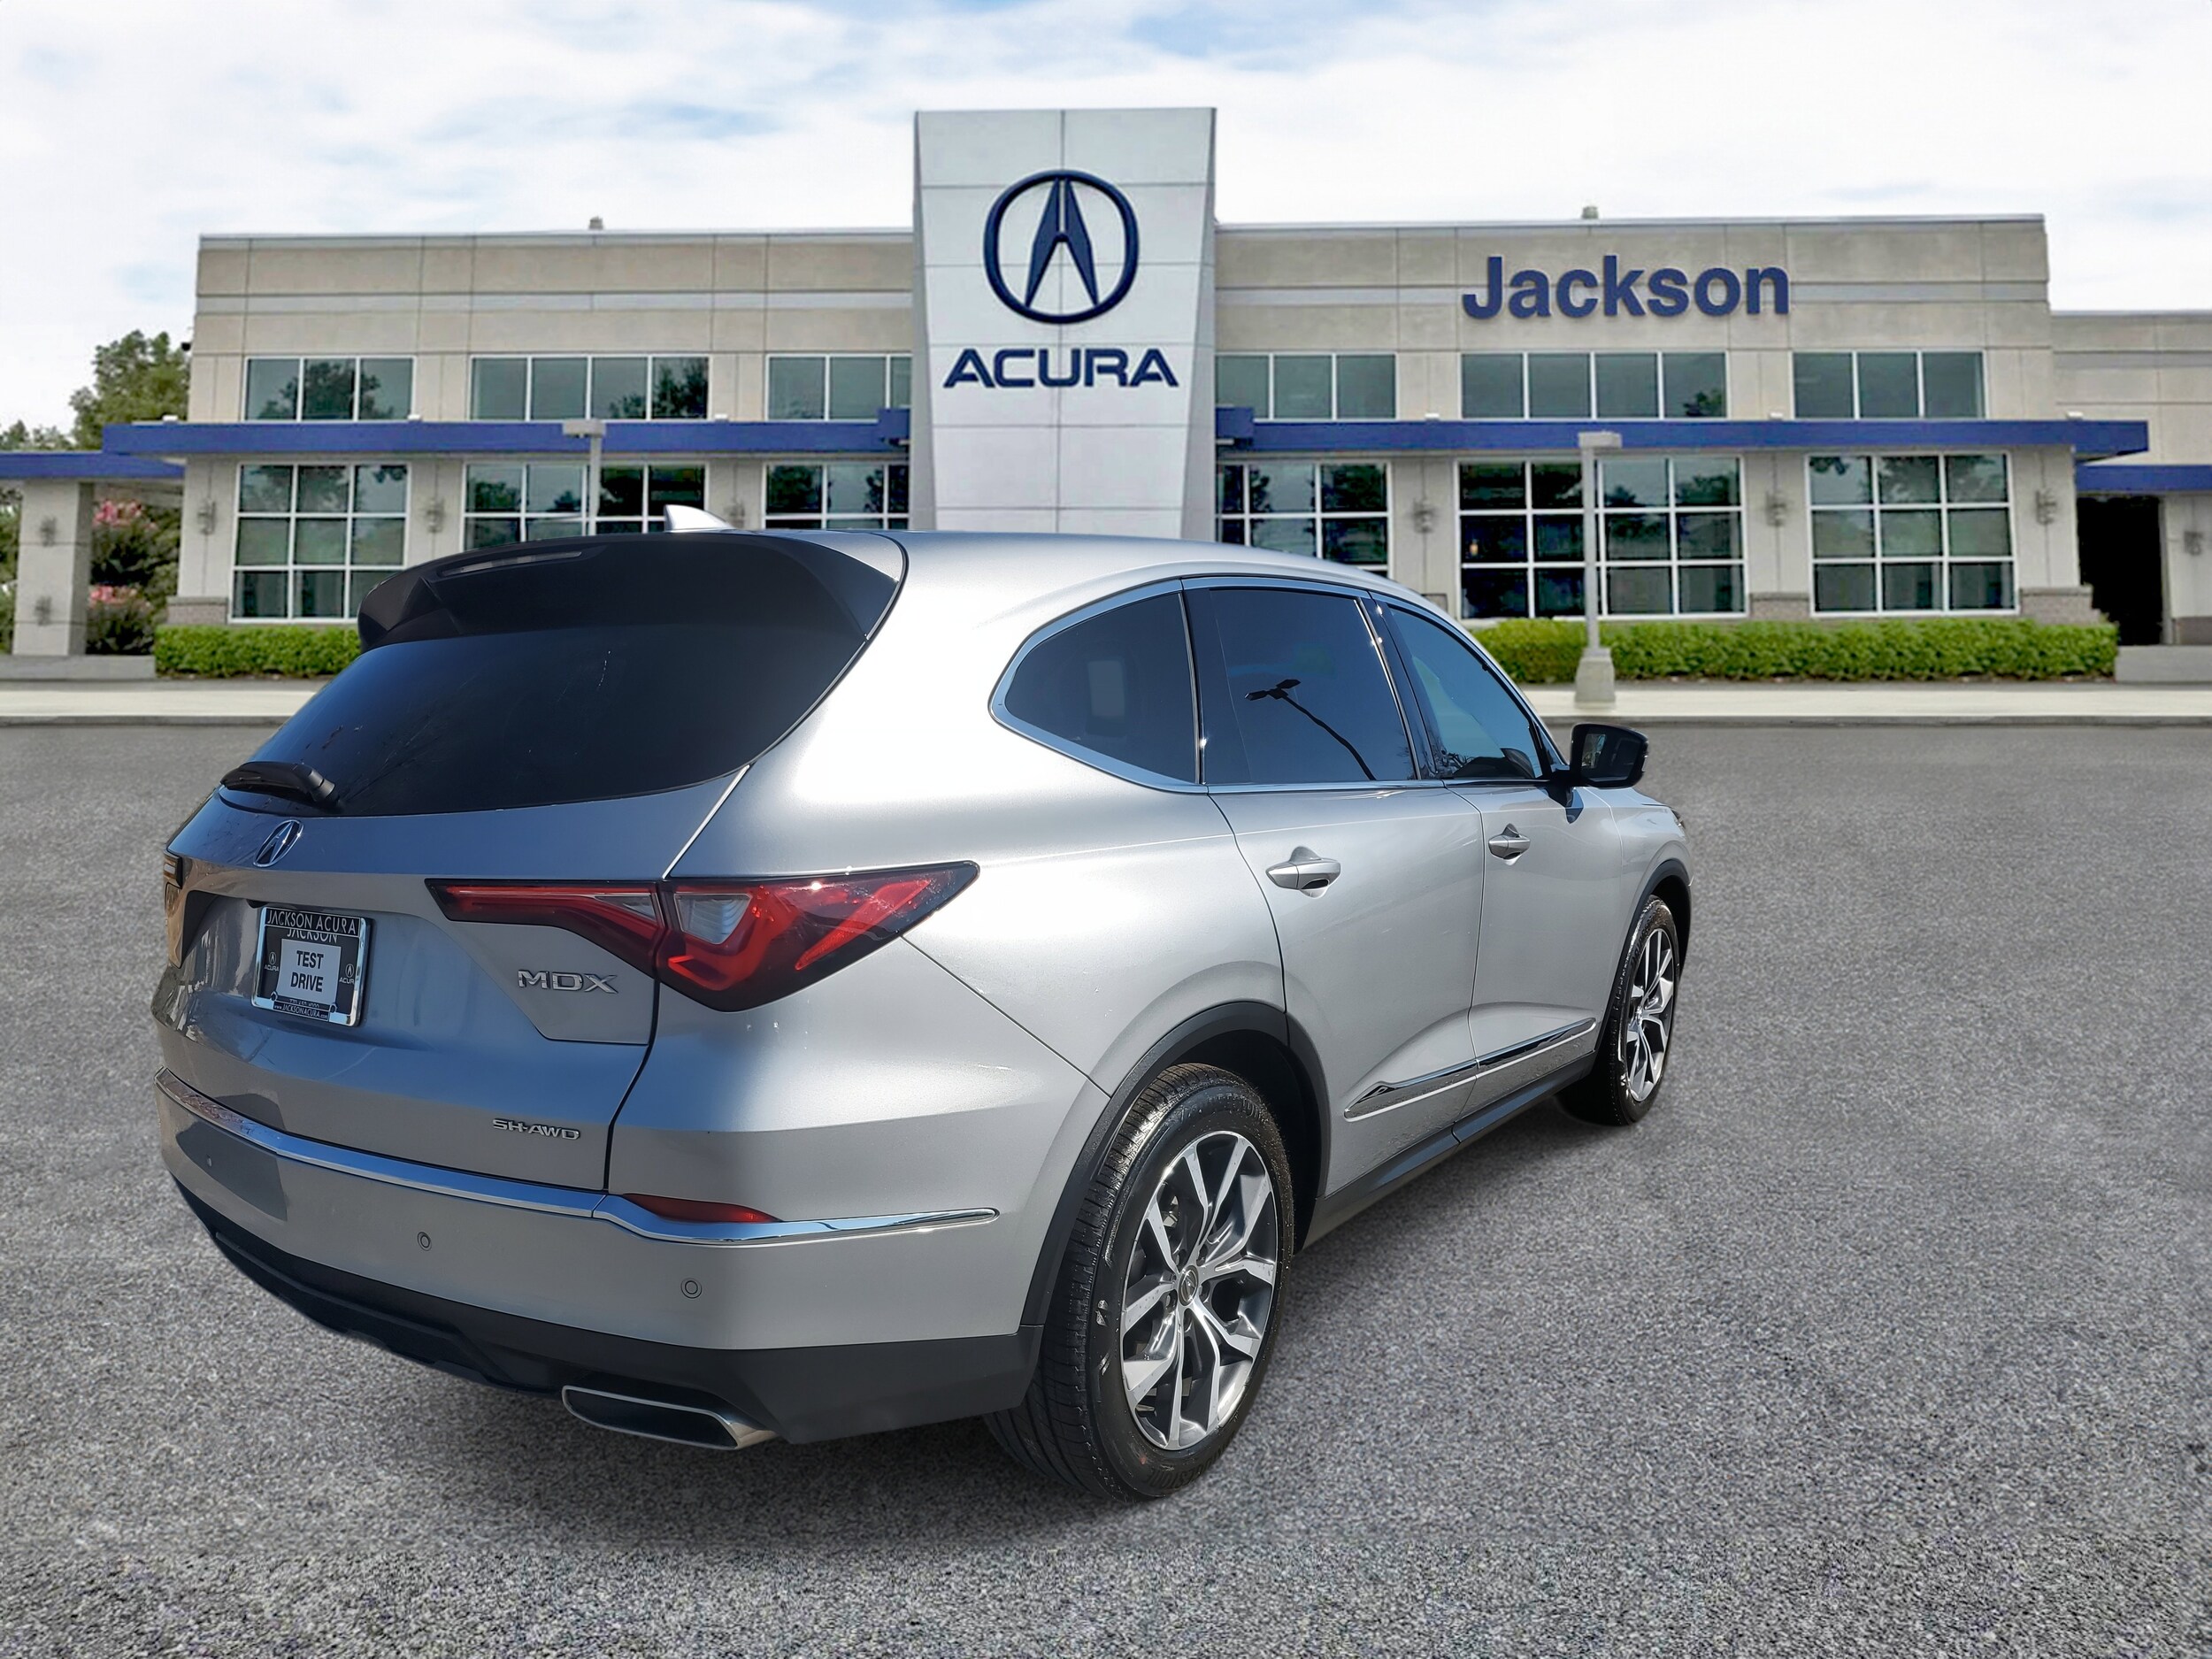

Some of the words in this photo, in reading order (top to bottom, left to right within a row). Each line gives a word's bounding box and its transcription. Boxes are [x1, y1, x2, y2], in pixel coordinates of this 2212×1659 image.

[1462, 255, 1790, 319] Jackson
[942, 348, 1179, 388] ACURA
[267, 910, 313, 929] JACKSON
[315, 915, 357, 935] ACURA
[296, 949, 324, 970] TEST
[290, 972, 324, 993] DRIVE
[518, 969, 618, 994] MDX
[492, 1118, 580, 1141] SH-AWD
